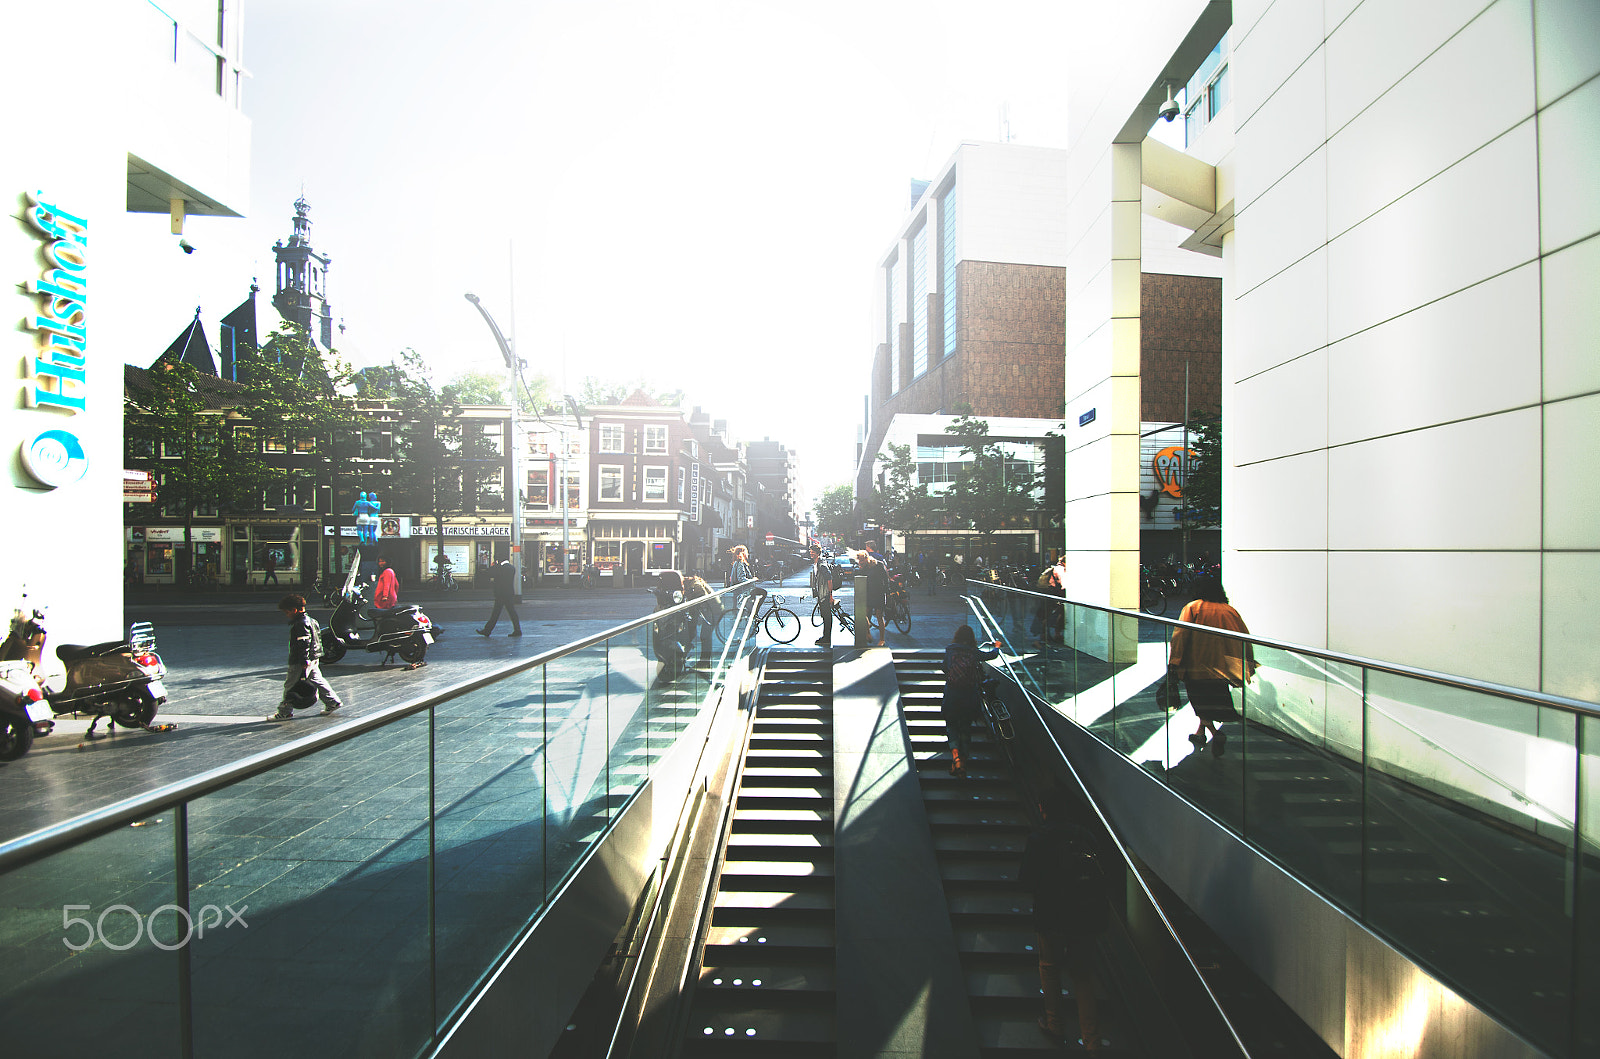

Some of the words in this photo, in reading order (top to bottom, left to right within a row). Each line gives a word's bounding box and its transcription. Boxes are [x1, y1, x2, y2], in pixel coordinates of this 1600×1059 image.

[35, 189, 88, 413] Hulshoff
[1157, 450, 1205, 488] PAT
[412, 526, 423, 535] DE
[424, 527, 479, 535] VEGTARISCHE
[481, 526, 509, 536] SLAGER
